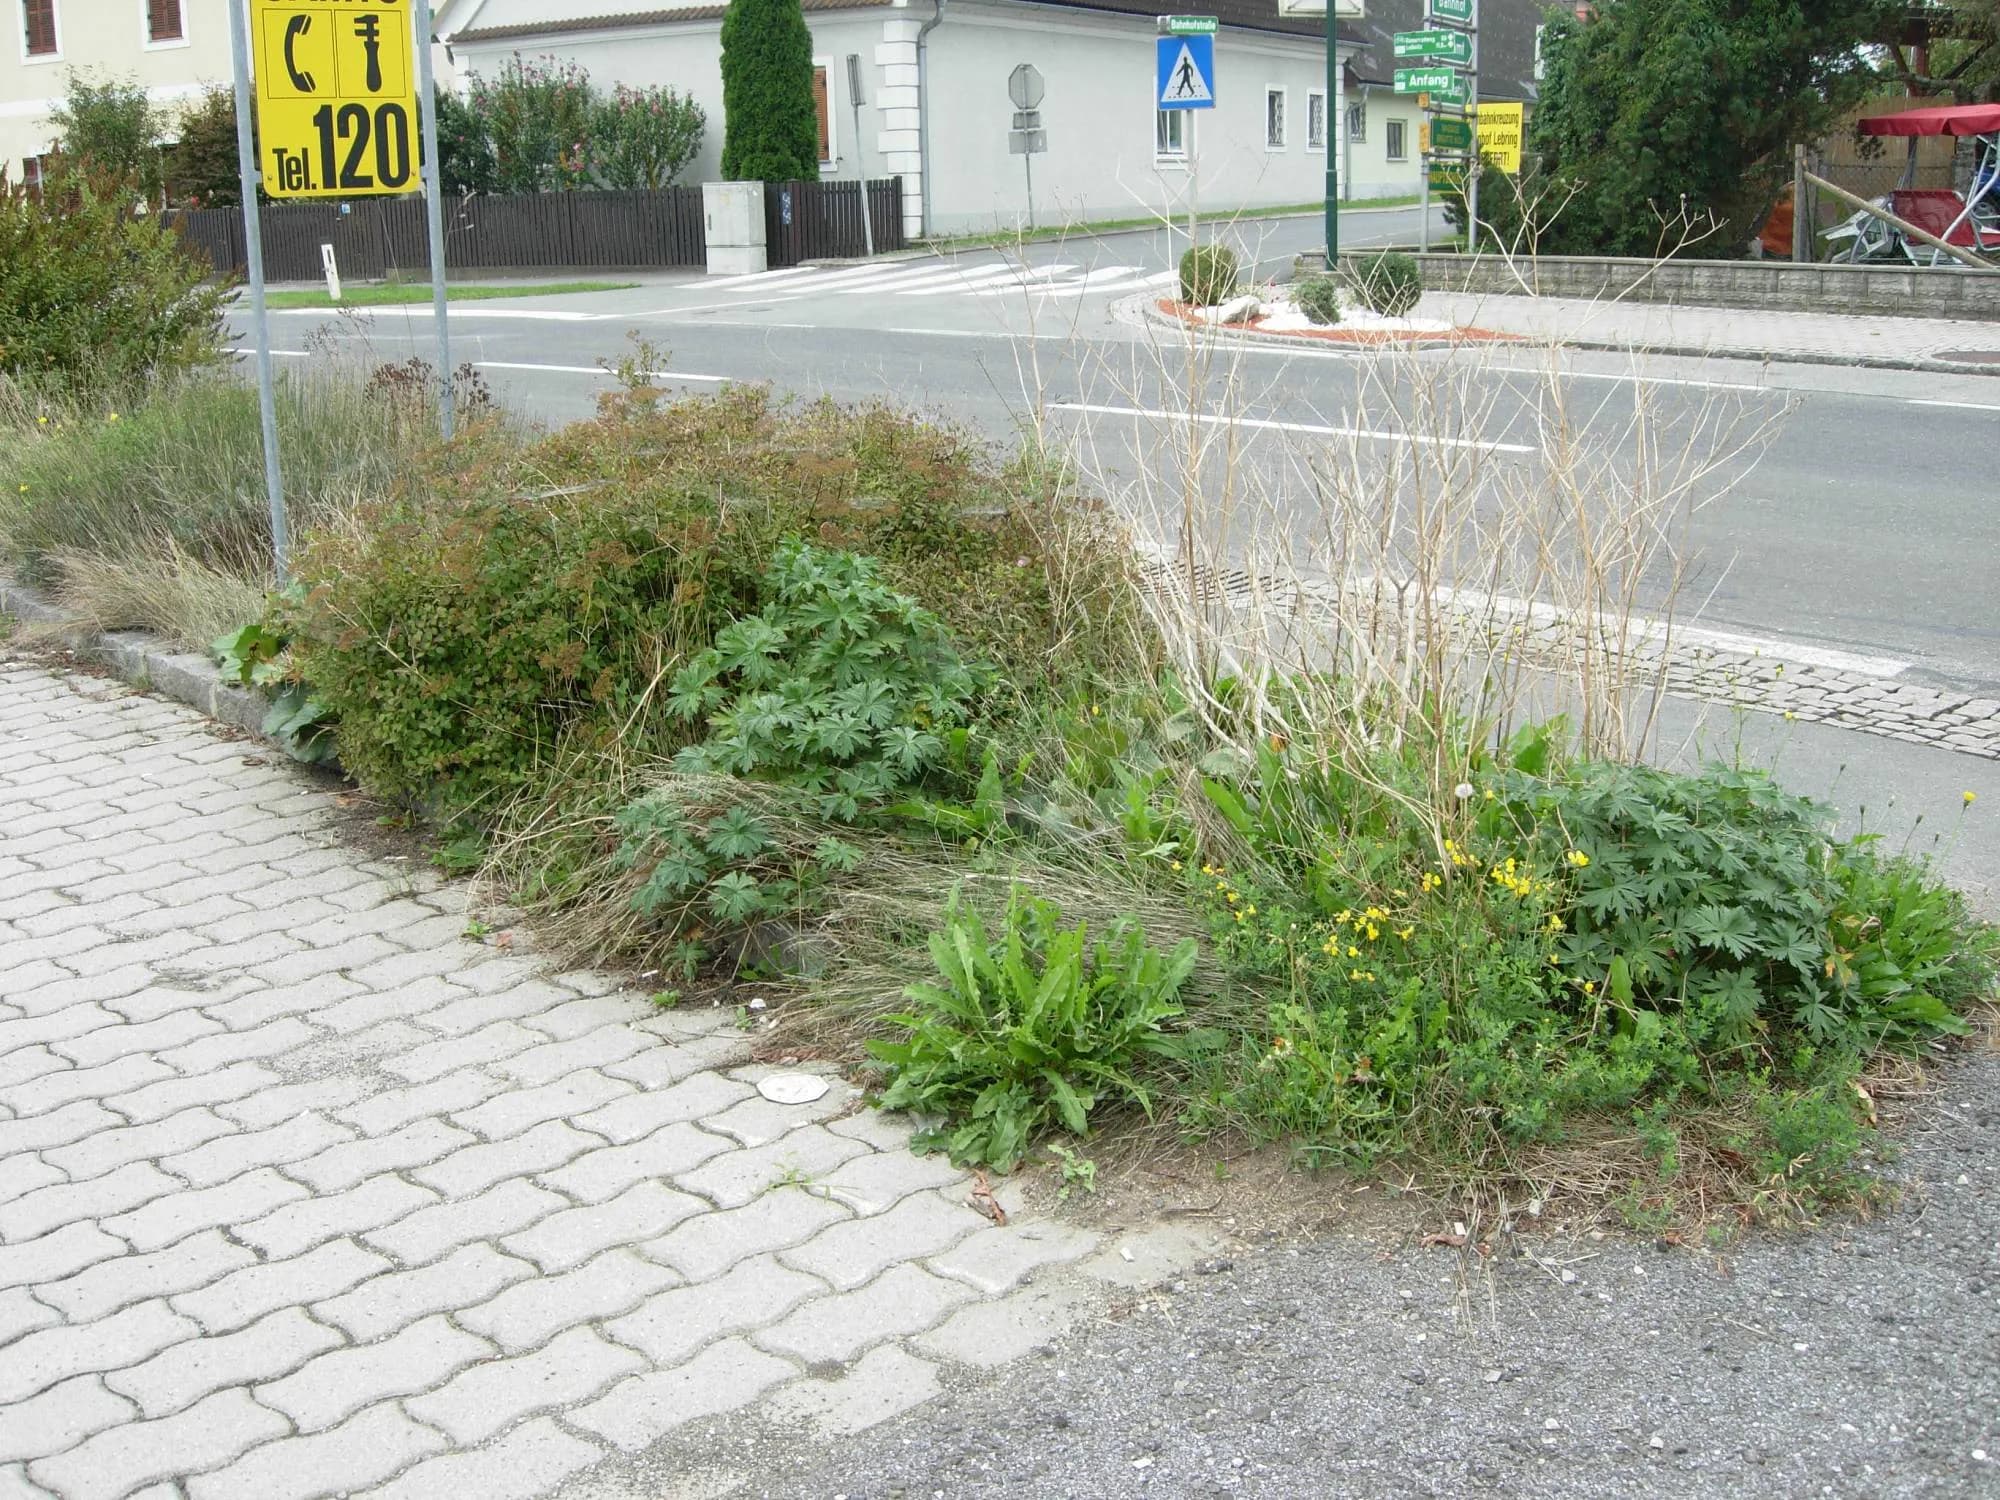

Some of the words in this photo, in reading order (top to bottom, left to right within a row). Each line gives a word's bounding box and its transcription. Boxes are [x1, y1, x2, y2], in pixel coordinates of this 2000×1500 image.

[1409, 74, 1449, 88] Anfang
[1478, 112, 1519, 128] bahnkreuzung
[272, 148, 317, 191] Tel.
[313, 102, 410, 190] 120
[1494, 131, 1518, 148] Lebring
